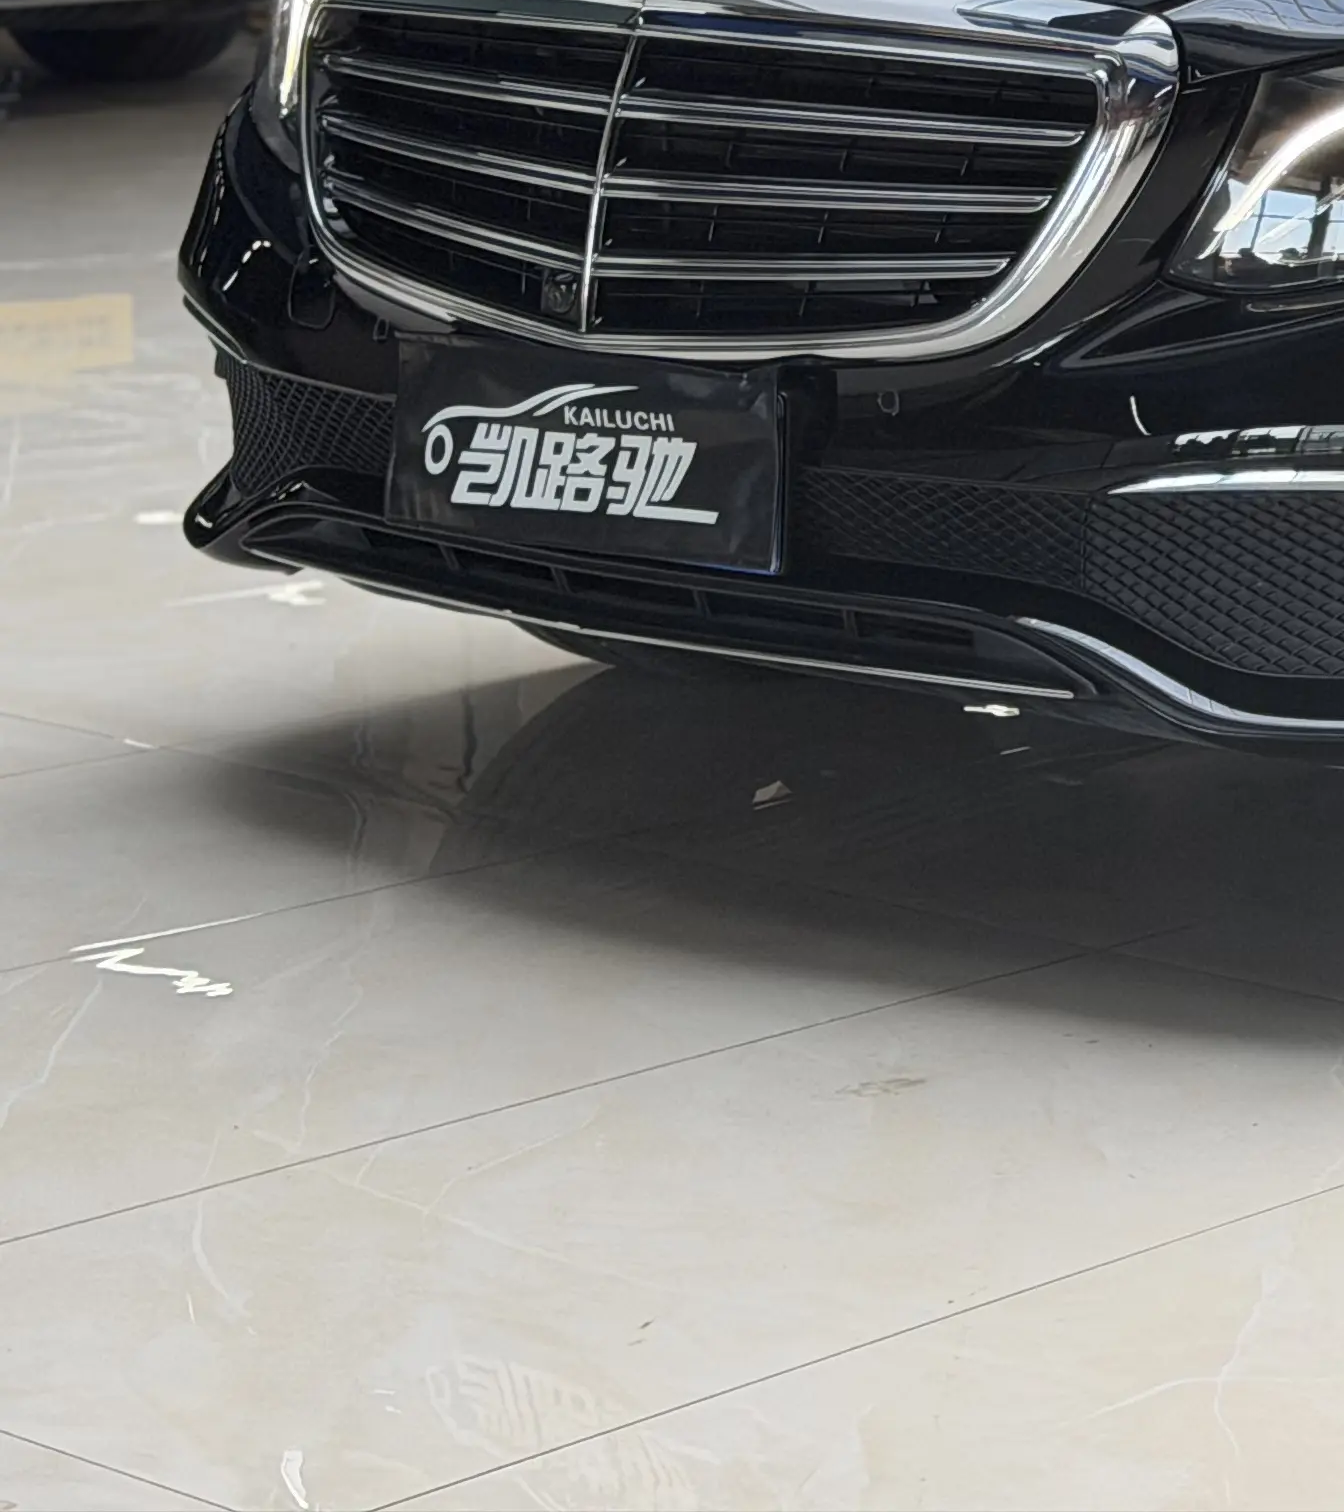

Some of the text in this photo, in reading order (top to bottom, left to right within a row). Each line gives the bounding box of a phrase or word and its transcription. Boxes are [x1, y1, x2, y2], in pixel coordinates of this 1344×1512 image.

[563, 405, 675, 432] KAILUCHI
[450, 421, 719, 525] 凯路驰
